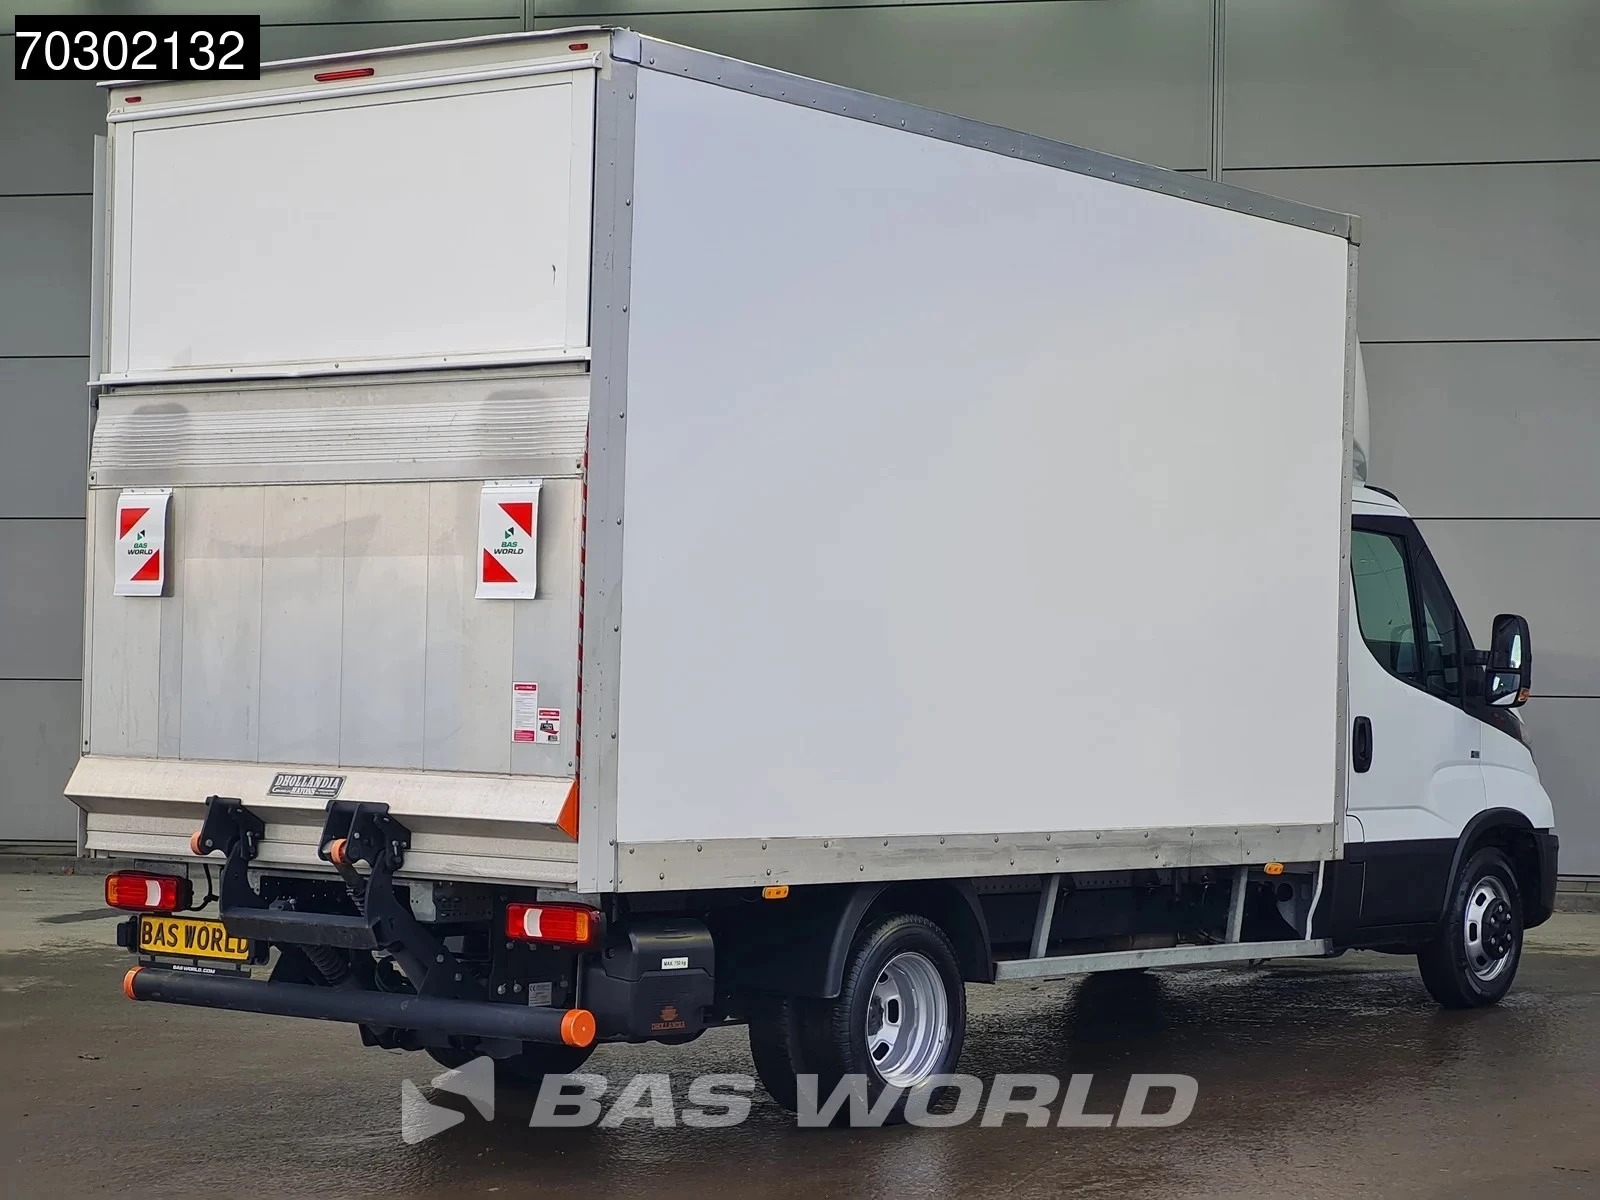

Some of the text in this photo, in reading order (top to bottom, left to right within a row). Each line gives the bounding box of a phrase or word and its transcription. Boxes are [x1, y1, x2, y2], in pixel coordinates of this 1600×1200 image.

[275, 775, 340, 789] DHOLLANDIA
[141, 921, 179, 948] BAS
[651, 1021, 686, 1031] DHOLLANDIA
